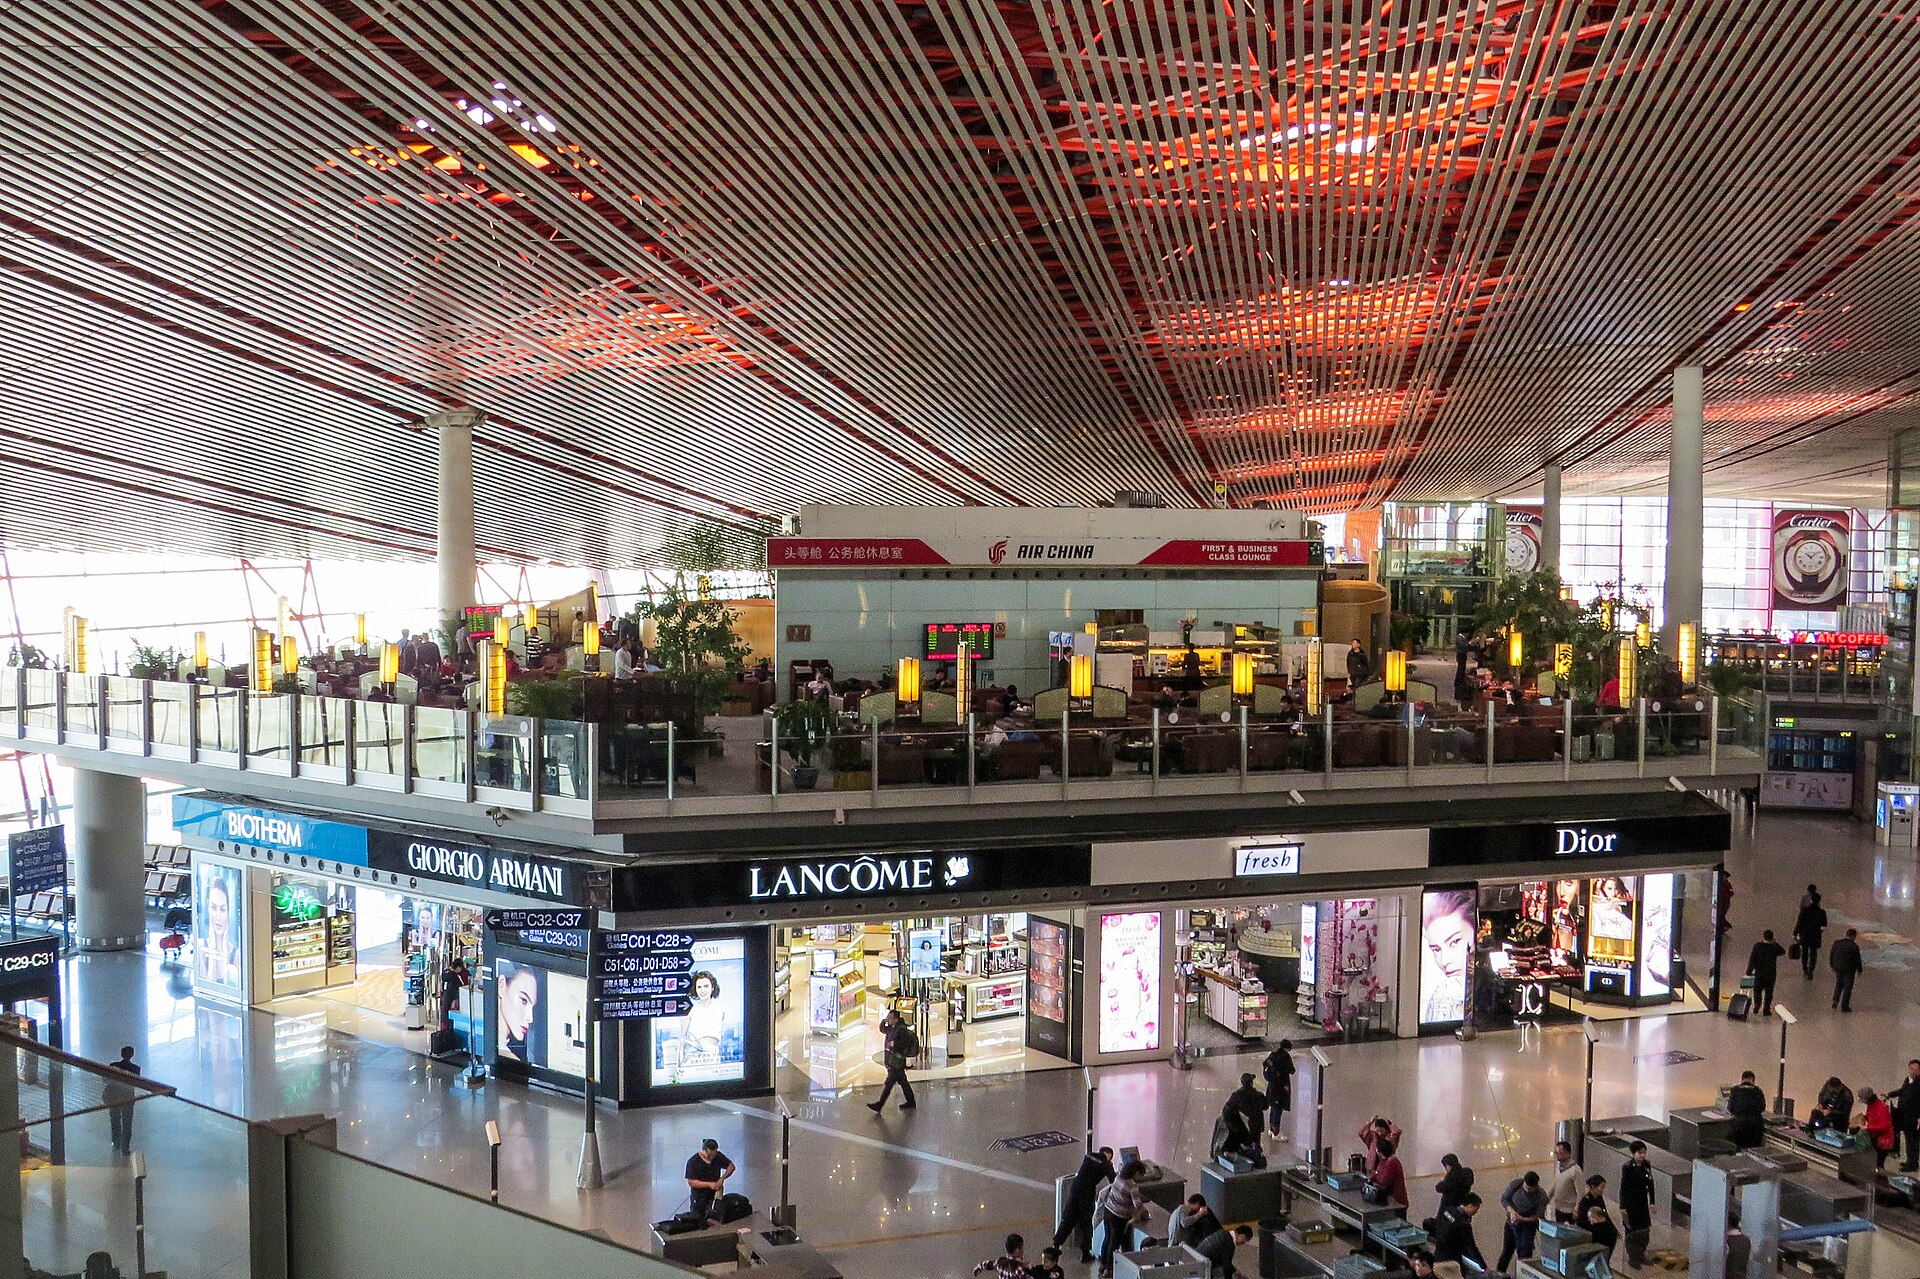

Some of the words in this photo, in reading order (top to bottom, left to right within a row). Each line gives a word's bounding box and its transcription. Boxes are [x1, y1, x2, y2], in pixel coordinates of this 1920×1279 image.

[1789, 513, 1835, 528] Cartier
[785, 547, 822, 559] 头等舱
[829, 547, 903, 559] 公务舱休息室
[1017, 545, 1044, 559] AIR
[1047, 545, 1095, 559] CHINA
[1202, 544, 1226, 553] FIRST
[1228, 545, 1235, 554] &
[1237, 545, 1278, 553] BUSINESS
[1208, 553, 1236, 561] CLASS
[1237, 553, 1272, 562] LOUNGE
[228, 811, 302, 848] BIOTHERM
[1555, 828, 1617, 855] Dior
[407, 842, 484, 881] GIORGIO
[488, 857, 563, 897] ARMANI
[1243, 850, 1291, 874] fresh
[749, 855, 933, 899] LANCÔME
[527, 913, 582, 927] C32-C37
[545, 930, 582, 947] C29-C31
[628, 933, 680, 948] C01-C28
[4, 951, 54, 972] C29-C31
